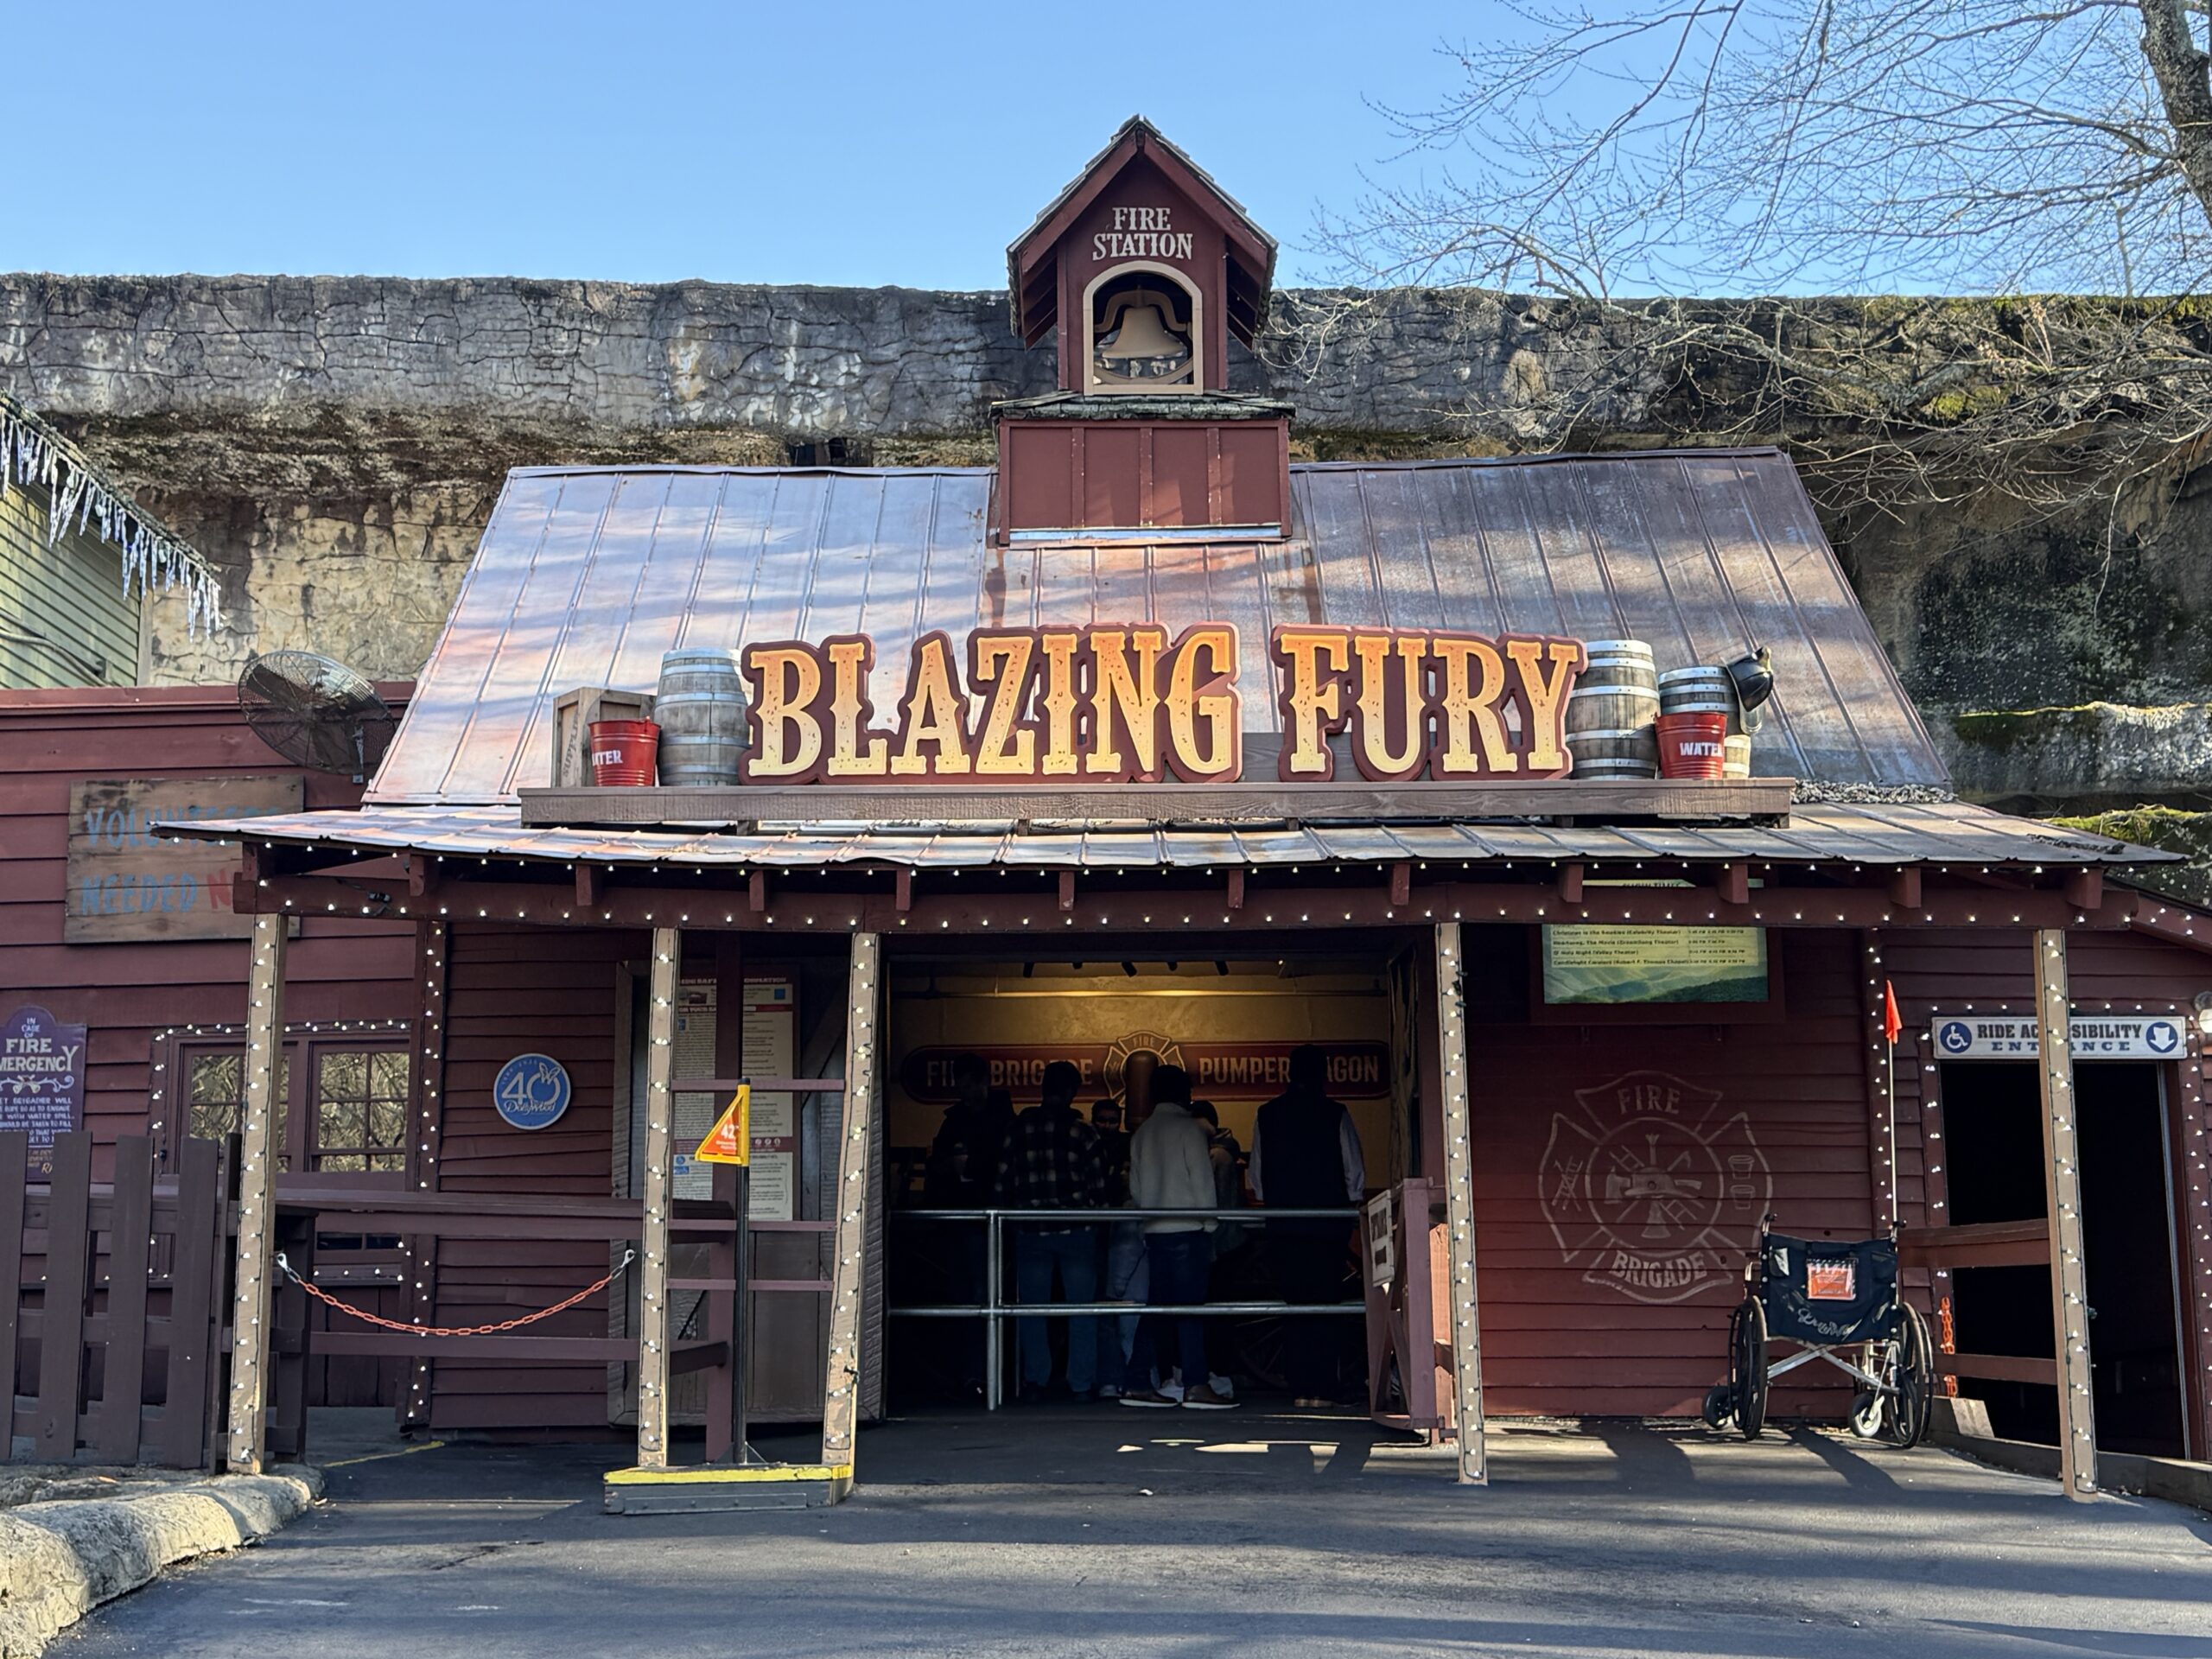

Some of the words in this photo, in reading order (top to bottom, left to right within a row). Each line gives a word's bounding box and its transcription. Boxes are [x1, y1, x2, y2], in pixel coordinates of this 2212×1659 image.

[1112, 207, 1171, 231] FIRE
[1092, 232, 1193, 261] STATION
[748, 631, 1233, 777] BLAZING
[1281, 633, 1579, 774] FURY
[81, 874, 198, 915] NEEDED
[6, 1038, 52, 1053] FIRE
[1133, 1034, 1154, 1047] FIRE
[1977, 1024, 2015, 1039] RIDE
[2020, 1024, 2142, 1039] ACSIBILITY
[989, 1058, 1093, 1086] BRIGE
[1198, 1056, 1293, 1084] PUMPER
[54, 1096, 72, 1104] WILL
[501, 1071, 561, 1105] 40
[1617, 1084, 1681, 1116] FIRE
[1608, 1249, 1708, 1289] BRIGADE
